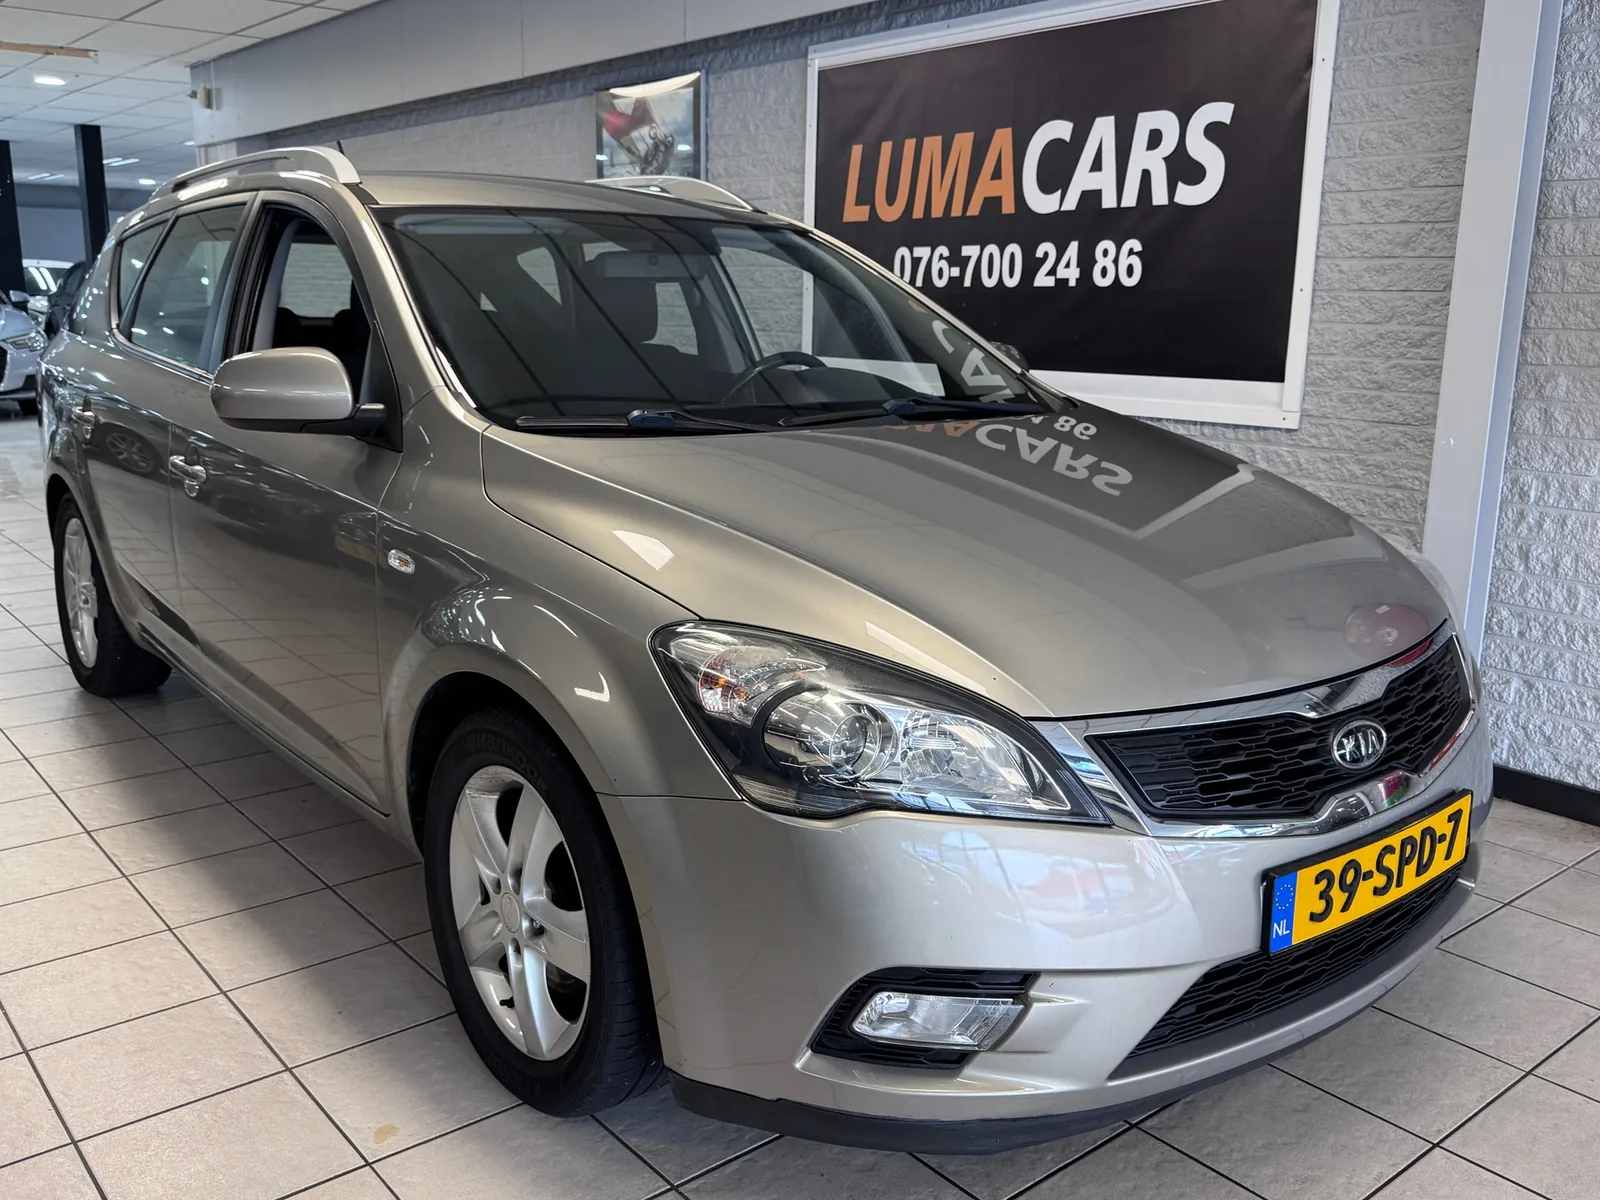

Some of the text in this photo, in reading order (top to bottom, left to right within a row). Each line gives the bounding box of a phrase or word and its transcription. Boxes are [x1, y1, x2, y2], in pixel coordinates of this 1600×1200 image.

[842, 101, 1235, 223] LUMACARS
[893, 239, 1143, 288] 076-700 24 86
[1341, 728, 1381, 762] KIA
[1309, 808, 1463, 923] 39-SPD-7
[1272, 921, 1290, 938] NL
